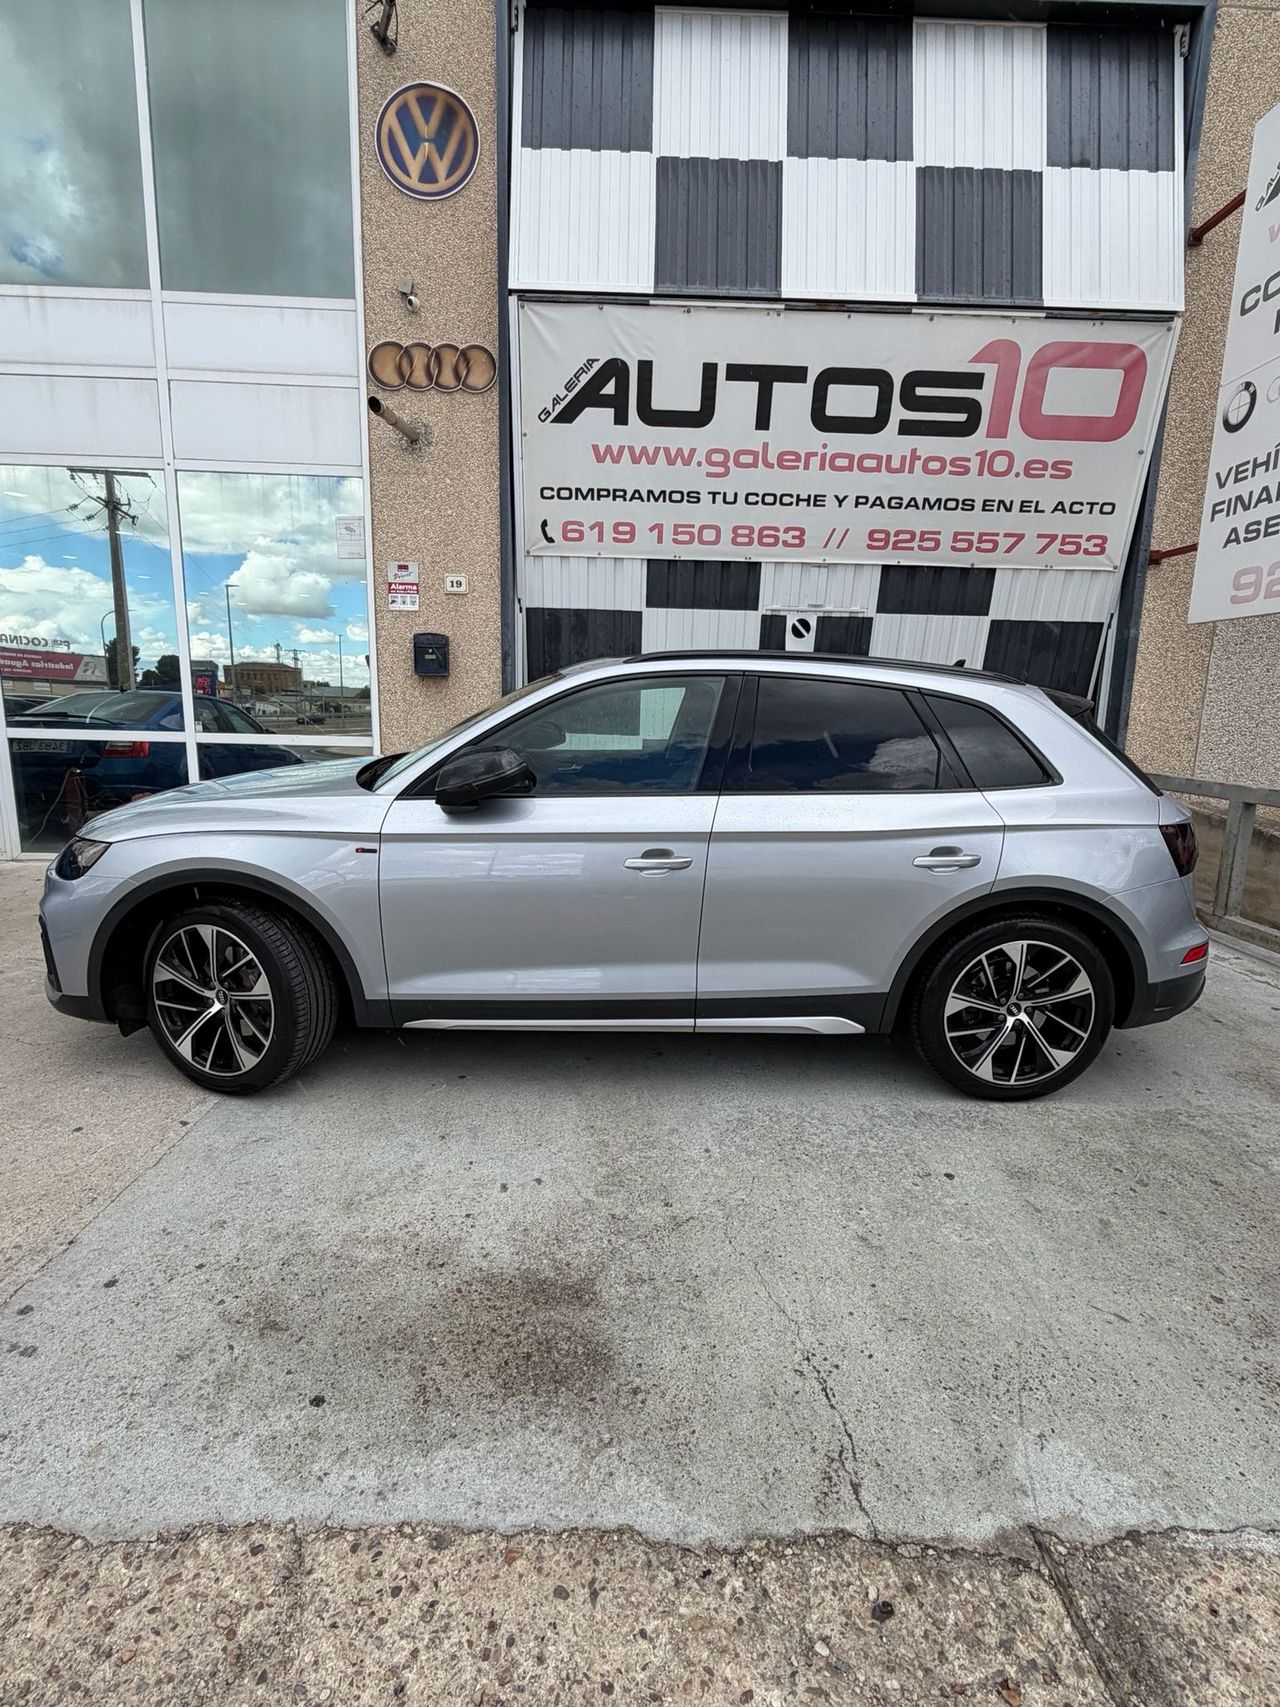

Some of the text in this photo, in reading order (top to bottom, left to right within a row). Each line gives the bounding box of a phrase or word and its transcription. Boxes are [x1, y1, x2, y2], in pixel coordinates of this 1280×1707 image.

[1254, 161, 1280, 212] GAL
[537, 357, 601, 424] GALERIA
[591, 441, 1073, 480] www.galeriaautos10.es
[539, 486, 1116, 516] COMPRAMOS TU COCHE Y PAGAMOS EN EL ACTO
[561, 520, 637, 544] 619
[648, 522, 722, 546] 150
[730, 525, 806, 549] 863
[866, 528, 942, 553] 925
[950, 531, 1026, 554] 557
[1035, 533, 1109, 556] 753
[449, 580, 462, 588] 19
